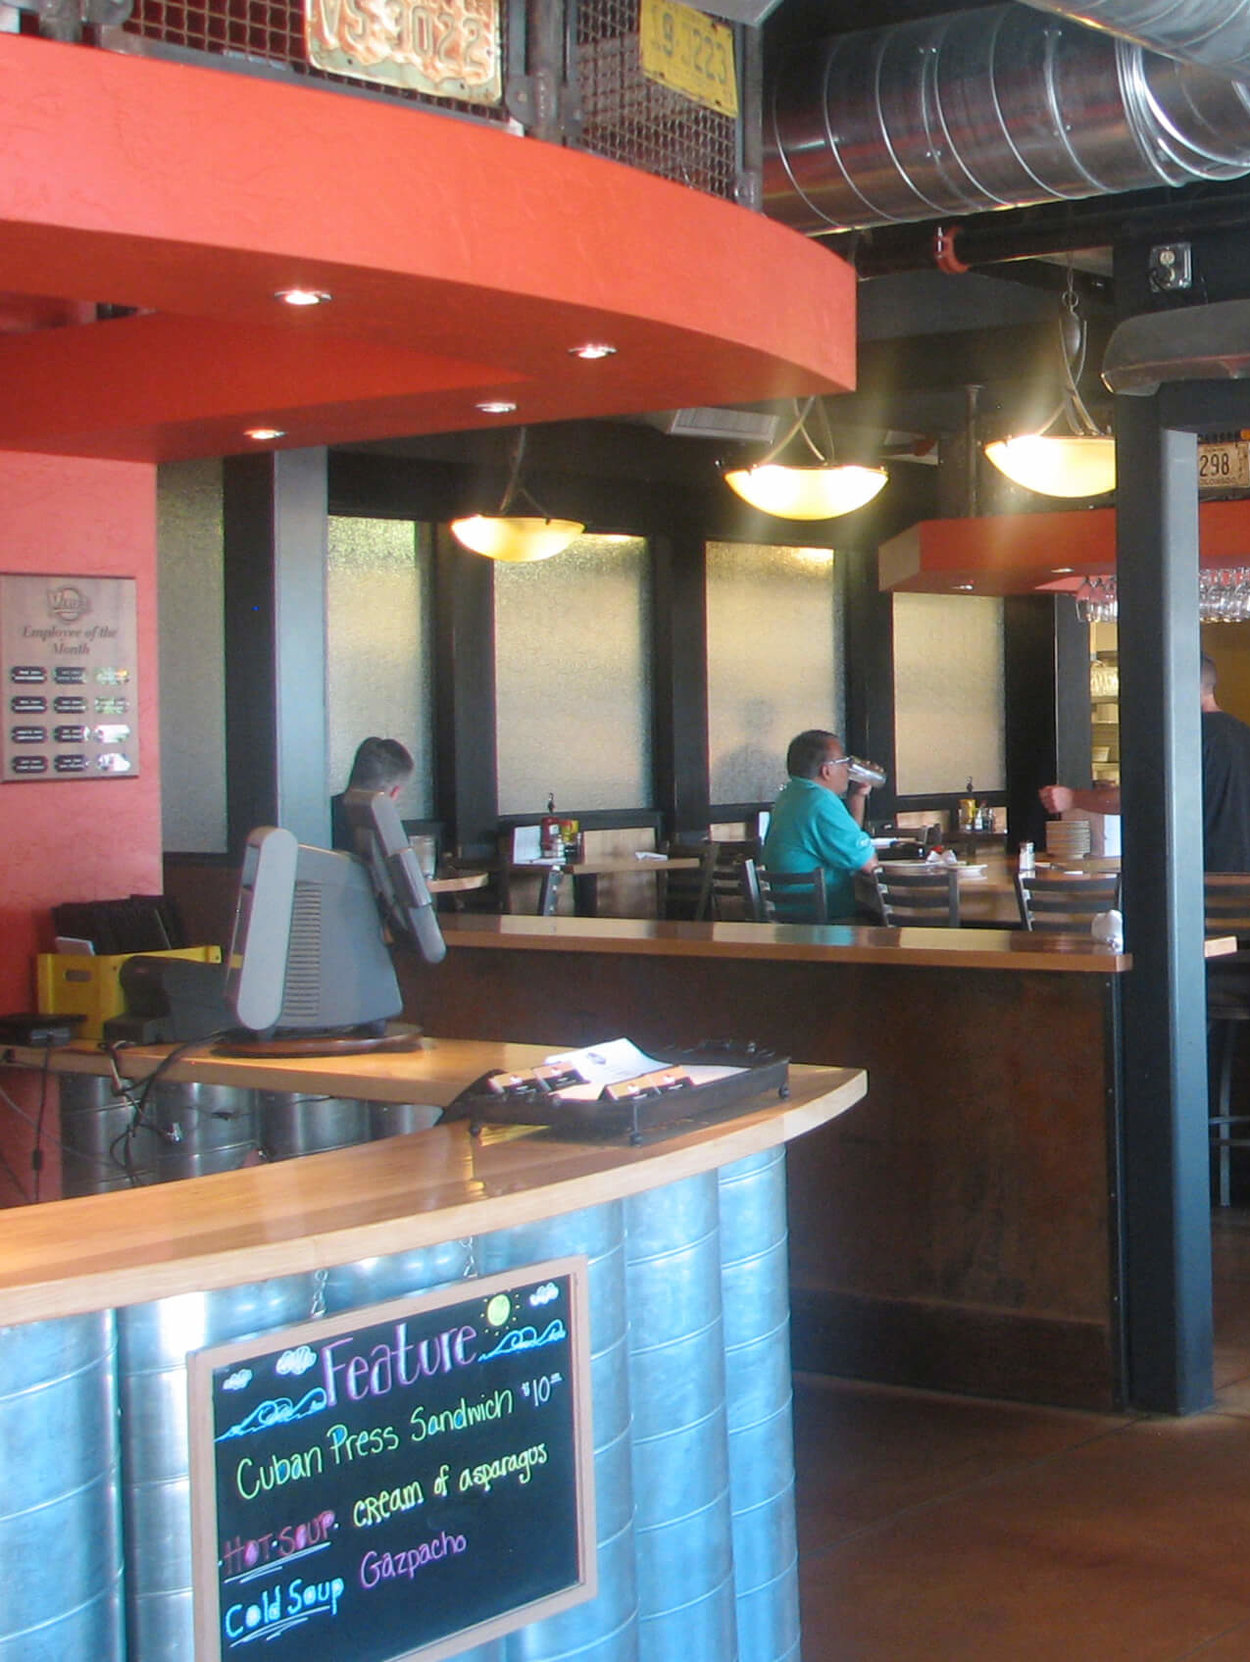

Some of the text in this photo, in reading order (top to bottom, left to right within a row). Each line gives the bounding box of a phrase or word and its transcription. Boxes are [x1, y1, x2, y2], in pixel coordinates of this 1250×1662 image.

[1199, 452, 1230, 477] 298
[23, 625, 117, 642] Employee of the
[54, 642, 90, 655] Month
[321, 1322, 479, 1408] Feature
[236, 1446, 323, 1500] Cuban
[326, 1423, 400, 1465] Press
[410, 1389, 513, 1442] Sandwich
[433, 1463, 450, 1497] of
[225, 1530, 468, 1638] Cold Soup Gazpacho
